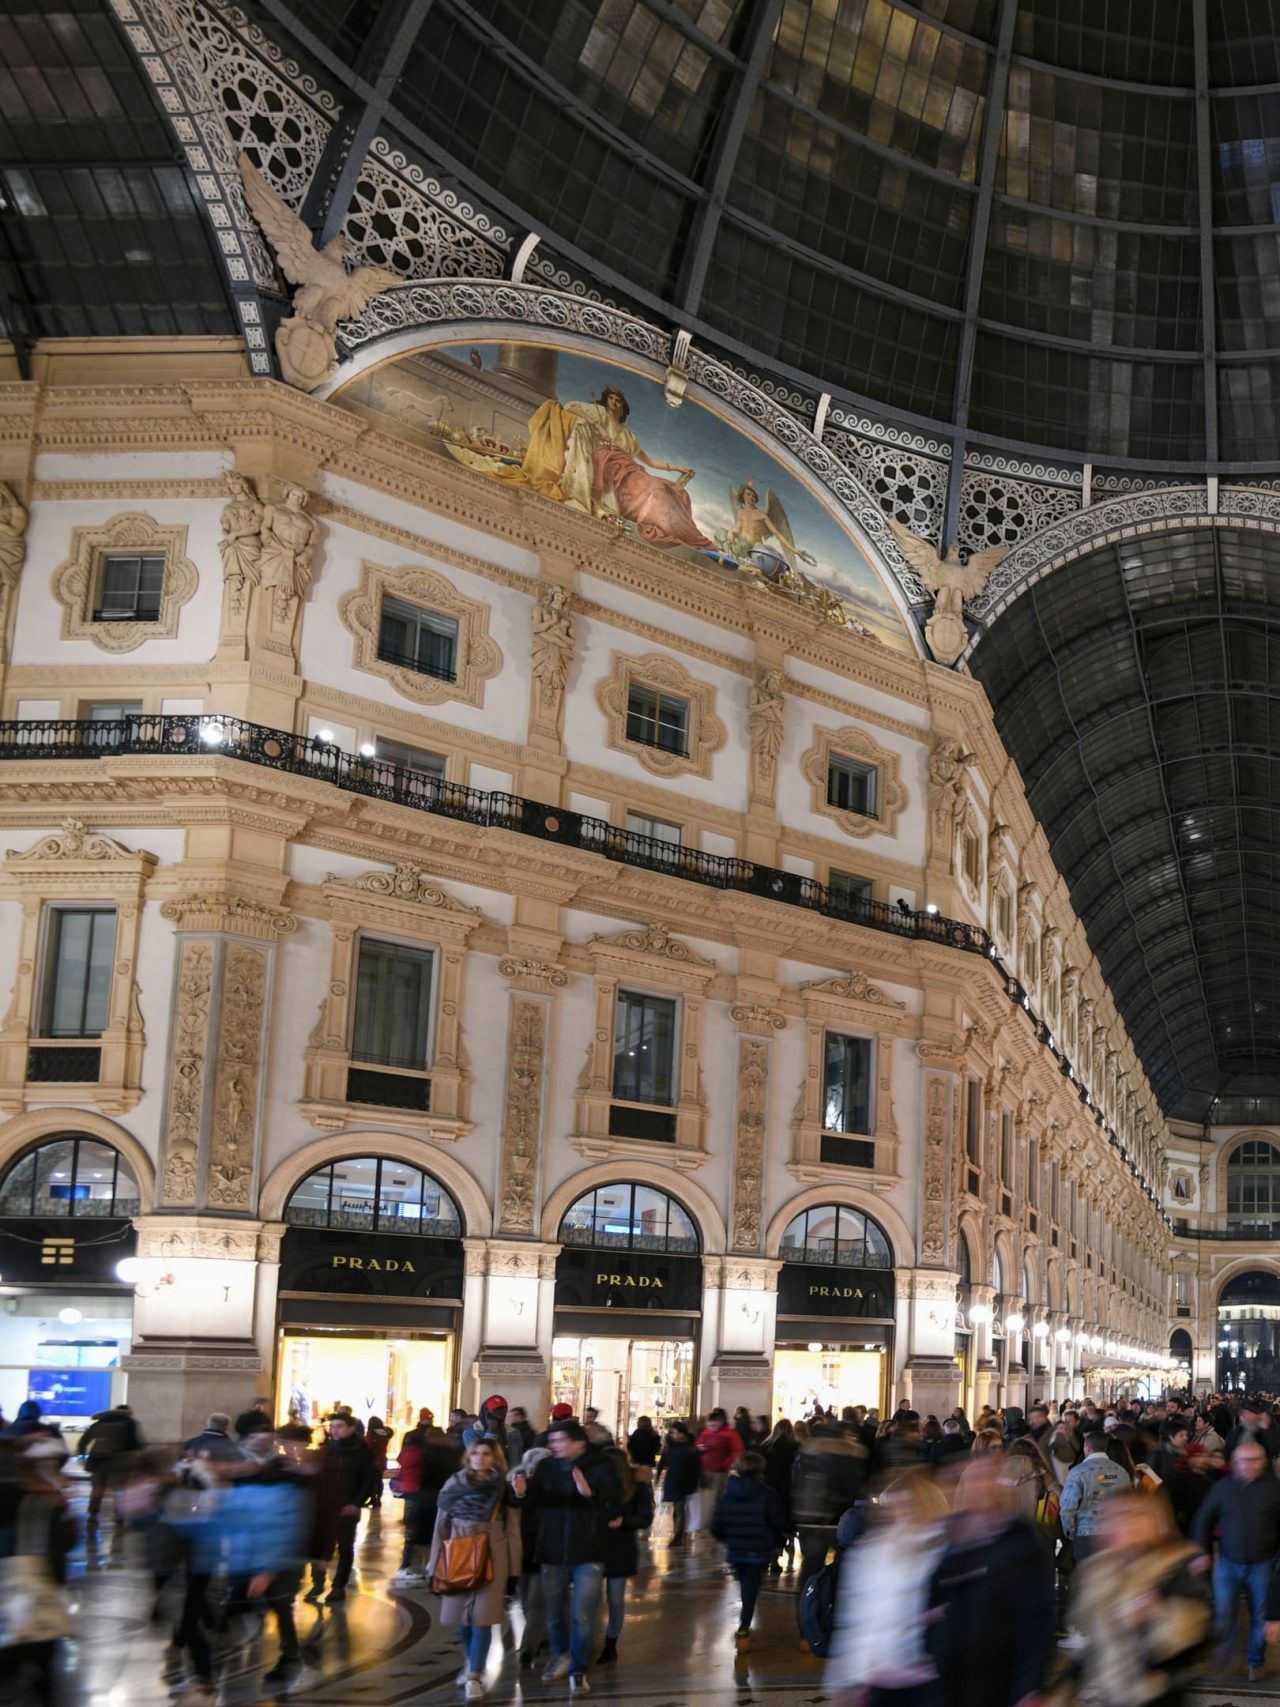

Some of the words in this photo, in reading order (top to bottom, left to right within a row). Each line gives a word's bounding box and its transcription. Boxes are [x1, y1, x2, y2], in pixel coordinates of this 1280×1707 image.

[332, 1255, 417, 1273] PRADA
[596, 1273, 664, 1288] PRADA
[808, 1286, 864, 1299] PRADA
